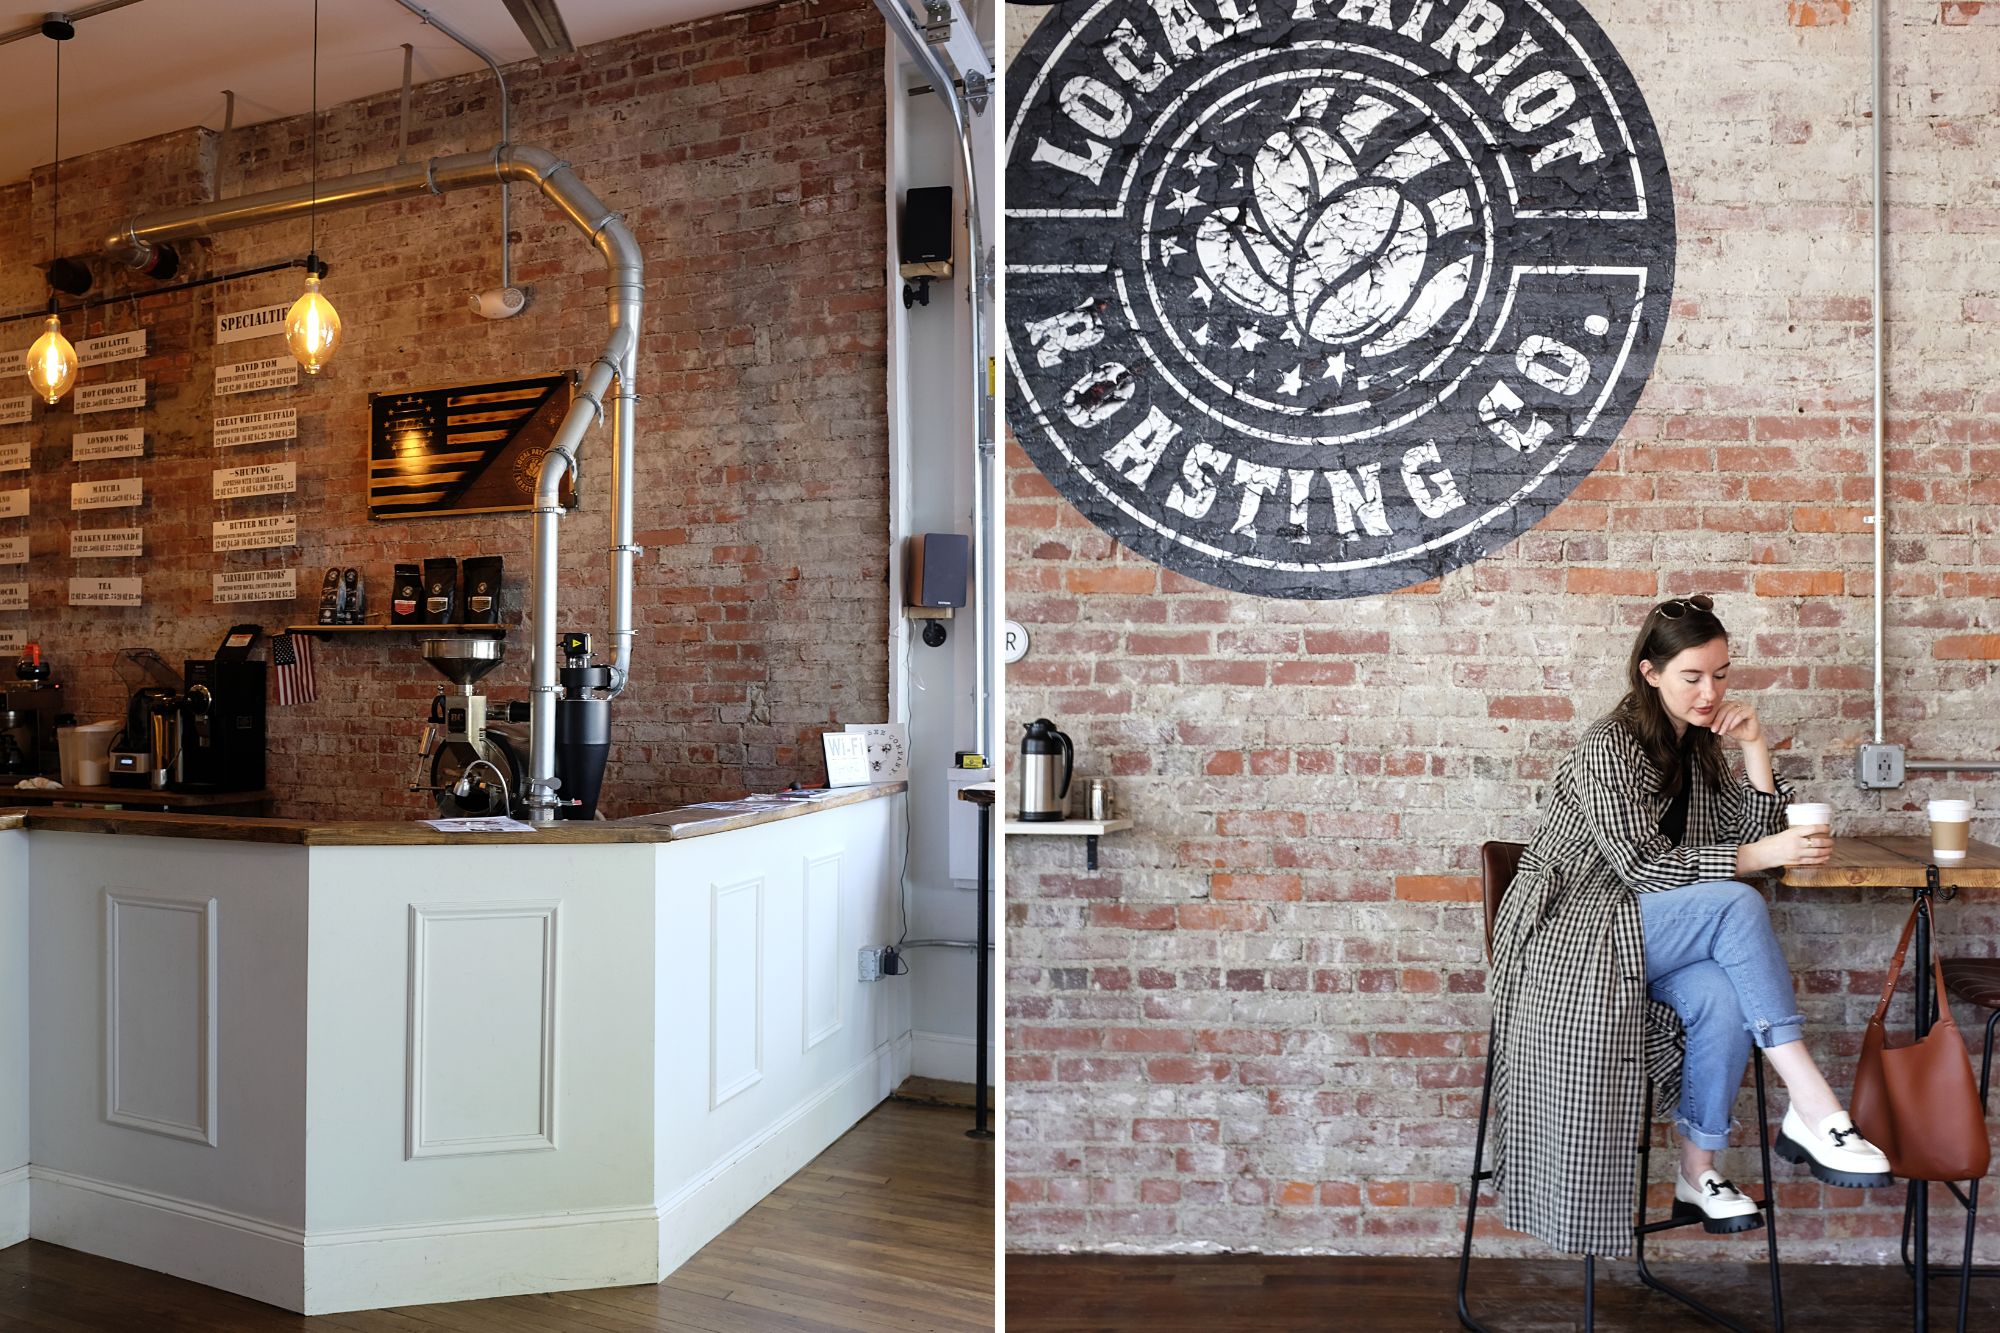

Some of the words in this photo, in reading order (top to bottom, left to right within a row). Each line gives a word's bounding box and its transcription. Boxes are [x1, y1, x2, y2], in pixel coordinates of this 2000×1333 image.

[221, 306, 291, 332] SPECIALTIE
[90, 341, 107, 350] CHAI
[108, 337, 129, 346] LATTE
[235, 361, 258, 372] DAVID
[260, 360, 277, 369] TOM
[82, 390, 96, 399] HOT
[97, 385, 137, 396] CHOCOLATE
[216, 417, 240, 427] GREAT
[240, 414, 262, 424] WHITE
[263, 410, 294, 421] BUFFALO
[1023, 297, 1467, 545] ROASTING
[1477, 314, 1609, 455] CO.
[87, 436, 114, 444] LONDON
[115, 434, 129, 442] FOG
[92, 485, 120, 493] MATCHA
[229, 521, 256, 530] BUTTER
[258, 519, 267, 528] ME
[269, 518, 279, 527] UP
[103, 533, 140, 541] LEMONADE
